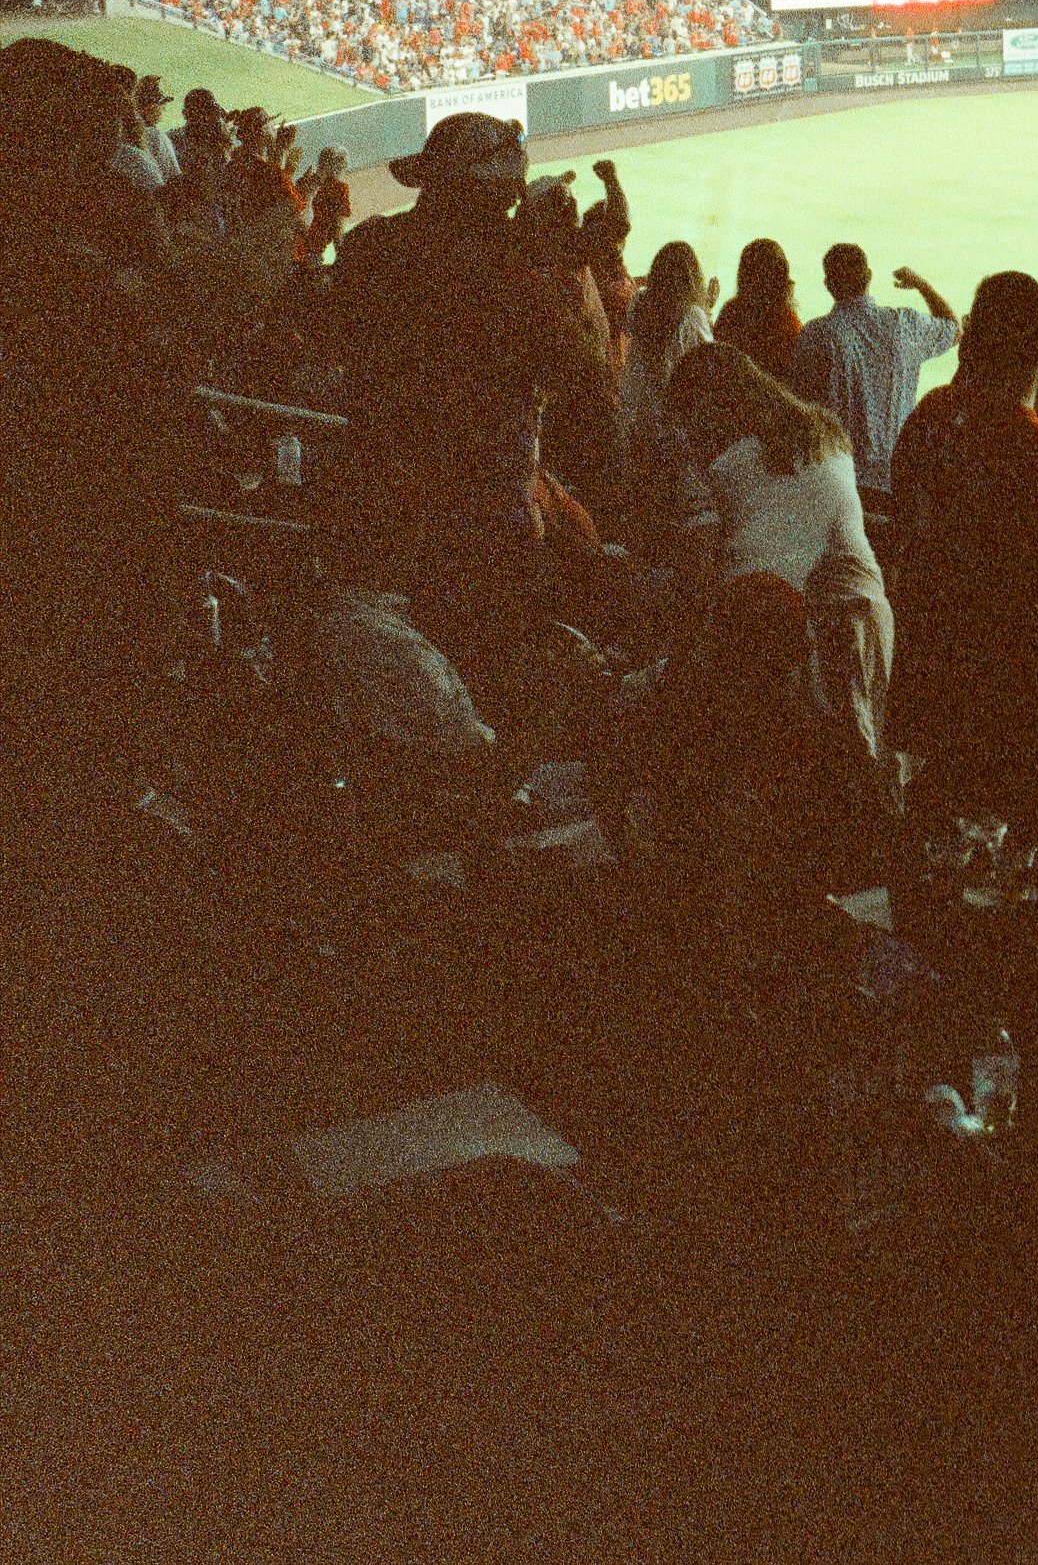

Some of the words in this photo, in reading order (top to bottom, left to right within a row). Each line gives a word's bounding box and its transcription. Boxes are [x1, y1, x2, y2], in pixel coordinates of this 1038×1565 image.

[855, 73, 894, 88] BUSCH
[897, 69, 950, 85] STADIUM
[429, 96, 459, 109] BANK
[462, 93, 475, 105] OF
[477, 88, 523, 103] AMERICA
[608, 71, 692, 113] bet365
